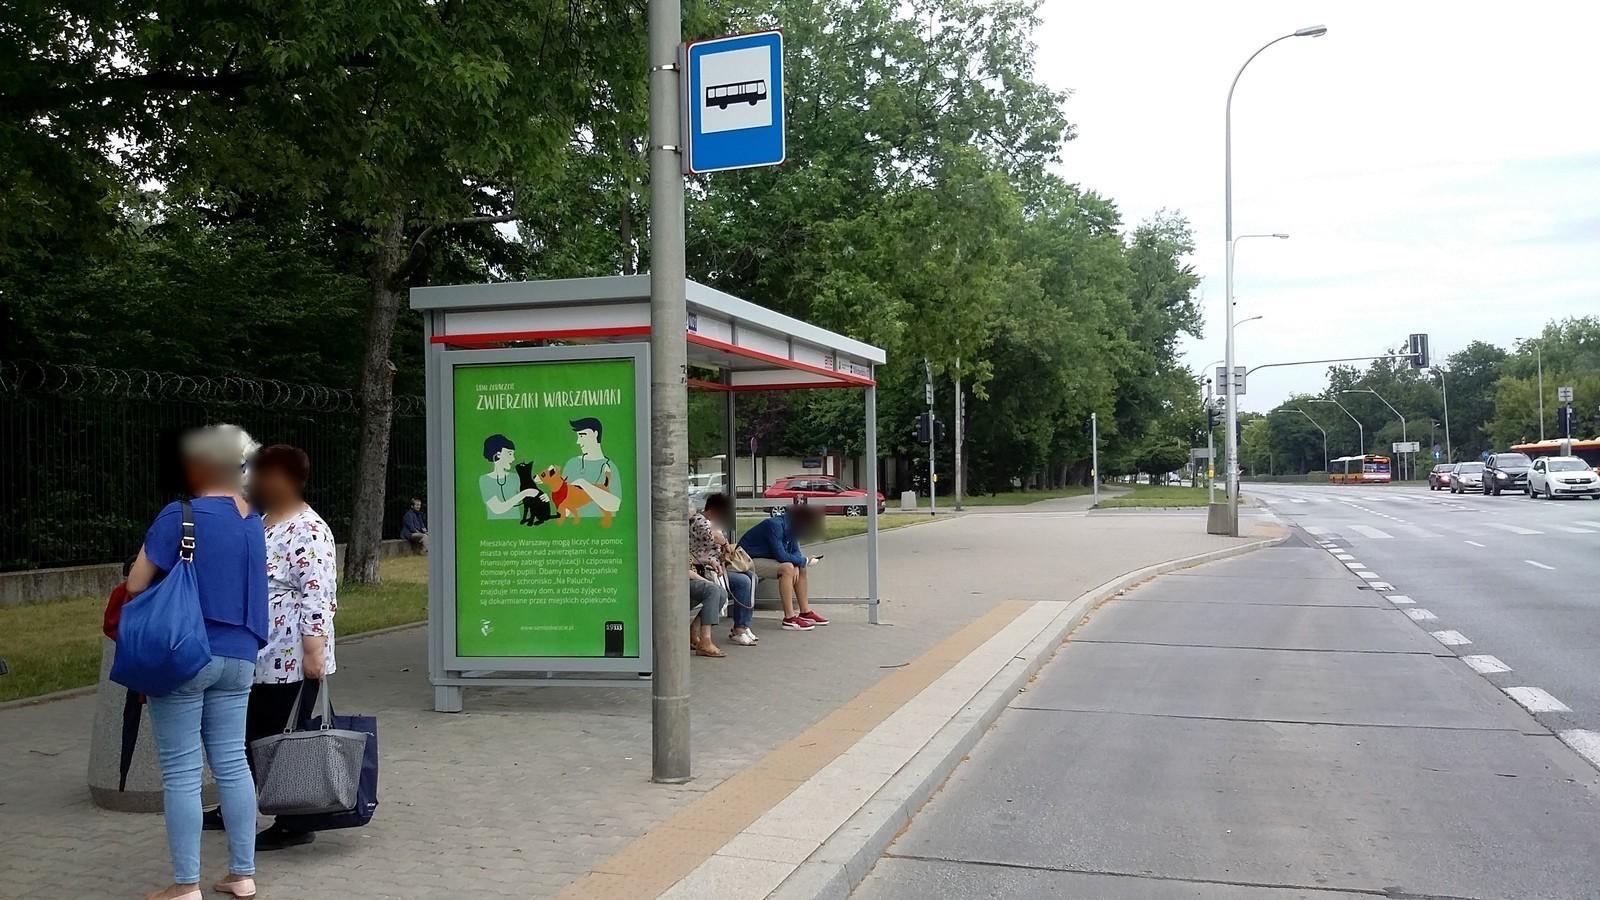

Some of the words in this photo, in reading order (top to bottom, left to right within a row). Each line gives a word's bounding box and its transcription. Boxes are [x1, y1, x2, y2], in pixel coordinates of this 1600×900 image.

[476, 393, 539, 411] ZWIERZAKI
[543, 388, 621, 408] WARSZAWIAKI
[480, 539, 517, 550] Mieszkańcy
[519, 539, 551, 548] Warszawy
[552, 540, 571, 549] mogą
[572, 538, 590, 548] liczyć
[601, 539, 624, 547] pomoc
[511, 550, 532, 558] opiece
[480, 559, 520, 568] finansujemy
[521, 558, 544, 567] zabiegi
[546, 557, 581, 567] sterylizacji
[585, 557, 623, 567] czipowania
[480, 568, 516, 577] domowych
[539, 567, 563, 577] Dbamy
[581, 567, 618, 576] bezpańskie
[480, 579, 511, 587] zwierzęta
[480, 587, 508, 596] znajduje
[519, 588, 538, 596] nowy
[580, 587, 602, 596] żyjące
[603, 586, 618, 596] koty
[488, 597, 528, 605] dokarmiane
[548, 597, 579, 605] miejskich
